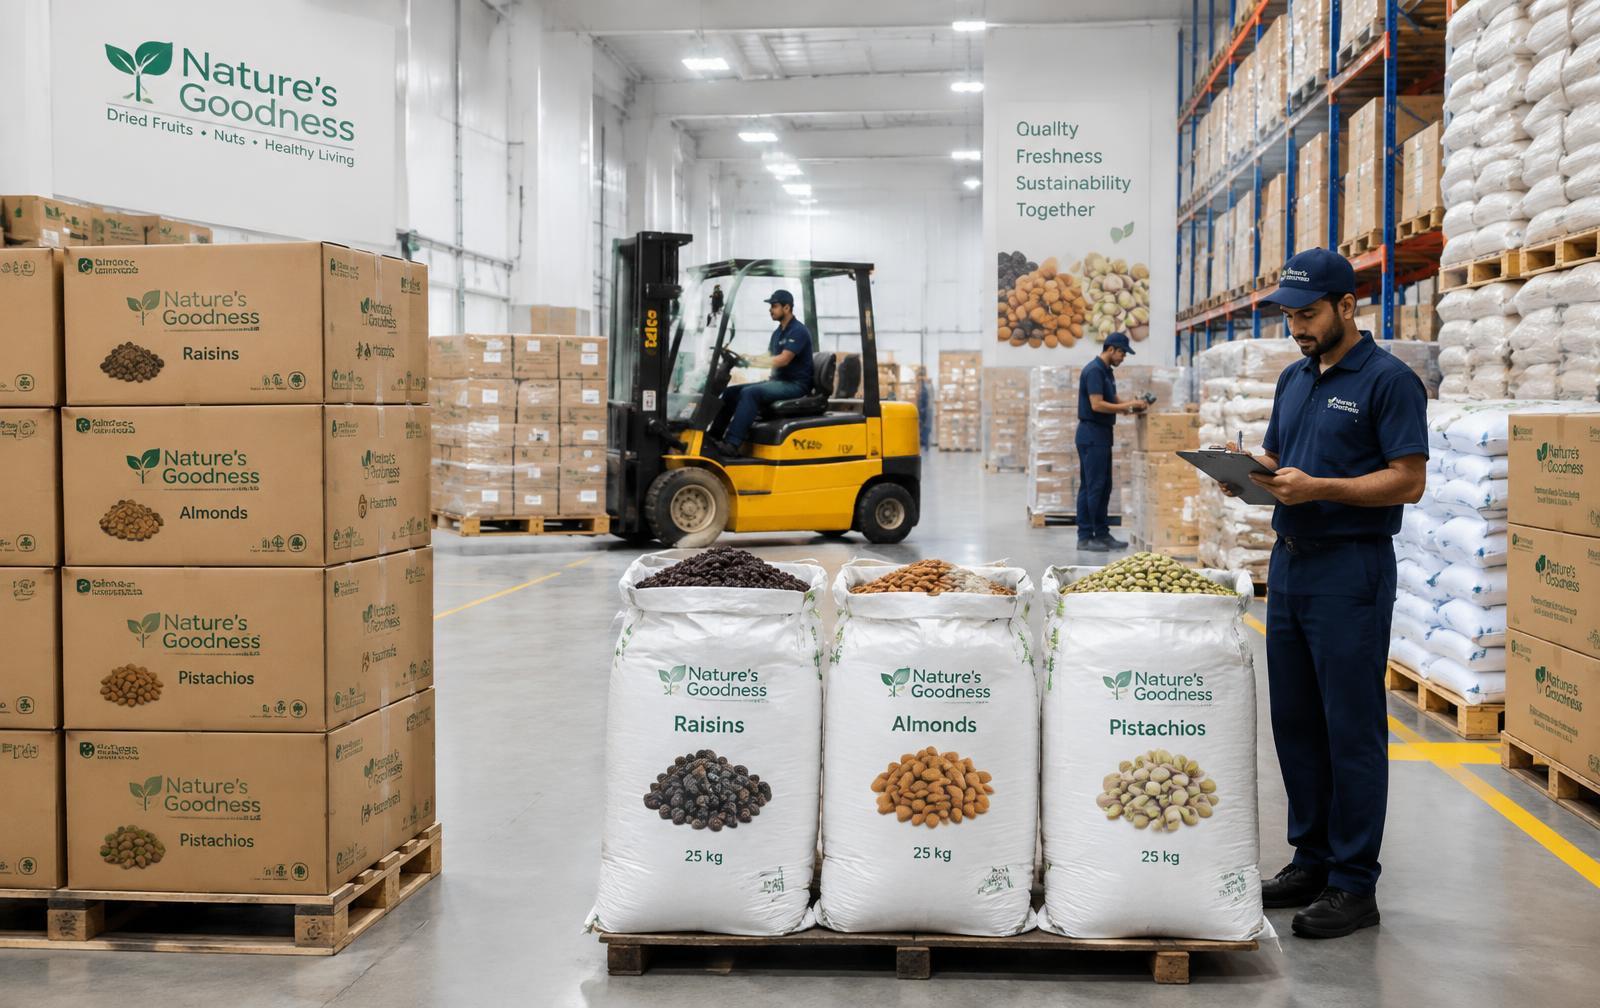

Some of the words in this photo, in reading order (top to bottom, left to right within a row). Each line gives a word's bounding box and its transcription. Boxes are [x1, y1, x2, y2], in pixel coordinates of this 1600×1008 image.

[182, 48, 338, 107] Nature's
[179, 83, 355, 142] Goodness
[108, 108, 147, 127] Dried
[153, 117, 193, 135] Fruits
[215, 129, 245, 145] Nuts
[265, 139, 315, 160] Healthy
[319, 149, 355, 168] Living
[1016, 147, 1103, 164] Freshness
[1016, 175, 1132, 194] Sustainability
[1016, 201, 1096, 221] Together
[164, 289, 248, 309] Nature's
[162, 308, 260, 326] Goodness
[183, 346, 240, 361] Raisins
[164, 449, 247, 467] Nature's
[162, 467, 260, 485] Goodness
[179, 505, 248, 520] Almonds
[164, 613, 248, 632] Nature's
[162, 632, 261, 650] Goodness
[178, 670, 255, 685] Pistachios
[688, 666, 759, 683] Nature's
[913, 668, 982, 684] Nature's
[1135, 671, 1204, 687] Nature's
[686, 680, 767, 697] Goodness
[911, 683, 991, 699] Goodness
[1134, 686, 1213, 702] Goodness
[674, 715, 745, 734] Raisins
[891, 715, 977, 733] Almonds
[1109, 718, 1206, 737] Pistachios
[166, 776, 248, 795] Nature's
[164, 795, 261, 813] Goodness
[180, 832, 255, 848] Pistachios
[684, 849, 703, 863] 25
[706, 849, 723, 866] kg
[913, 846, 931, 859] 25
[934, 846, 952, 863] kg
[1141, 850, 1159, 863] 25
[1163, 850, 1180, 866] kg
